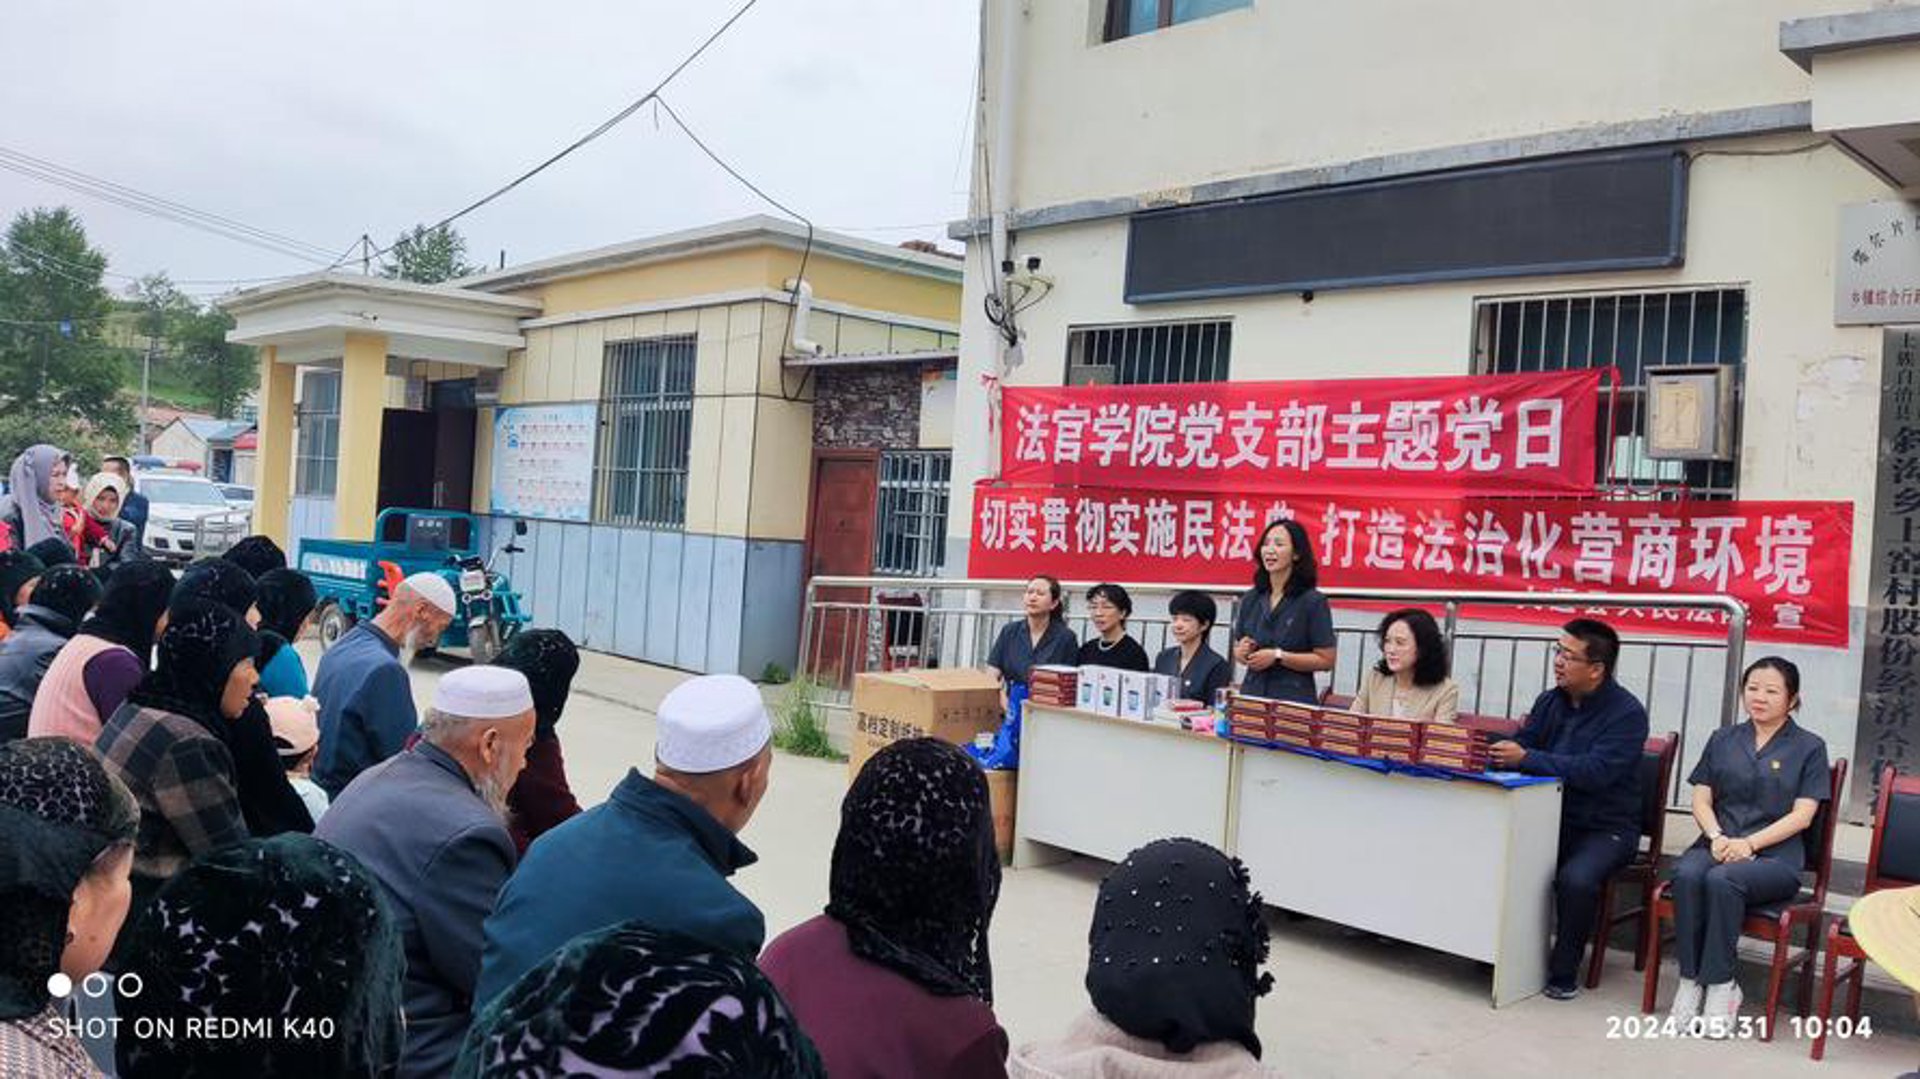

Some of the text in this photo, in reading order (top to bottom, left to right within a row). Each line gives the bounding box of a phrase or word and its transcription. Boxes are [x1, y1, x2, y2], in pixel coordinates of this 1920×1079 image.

[1017, 396, 1562, 472] 法官学院党支部主题党日
[1320, 502, 1813, 596] 打造法治化营商环境
[1773, 602, 1805, 630] 宣
